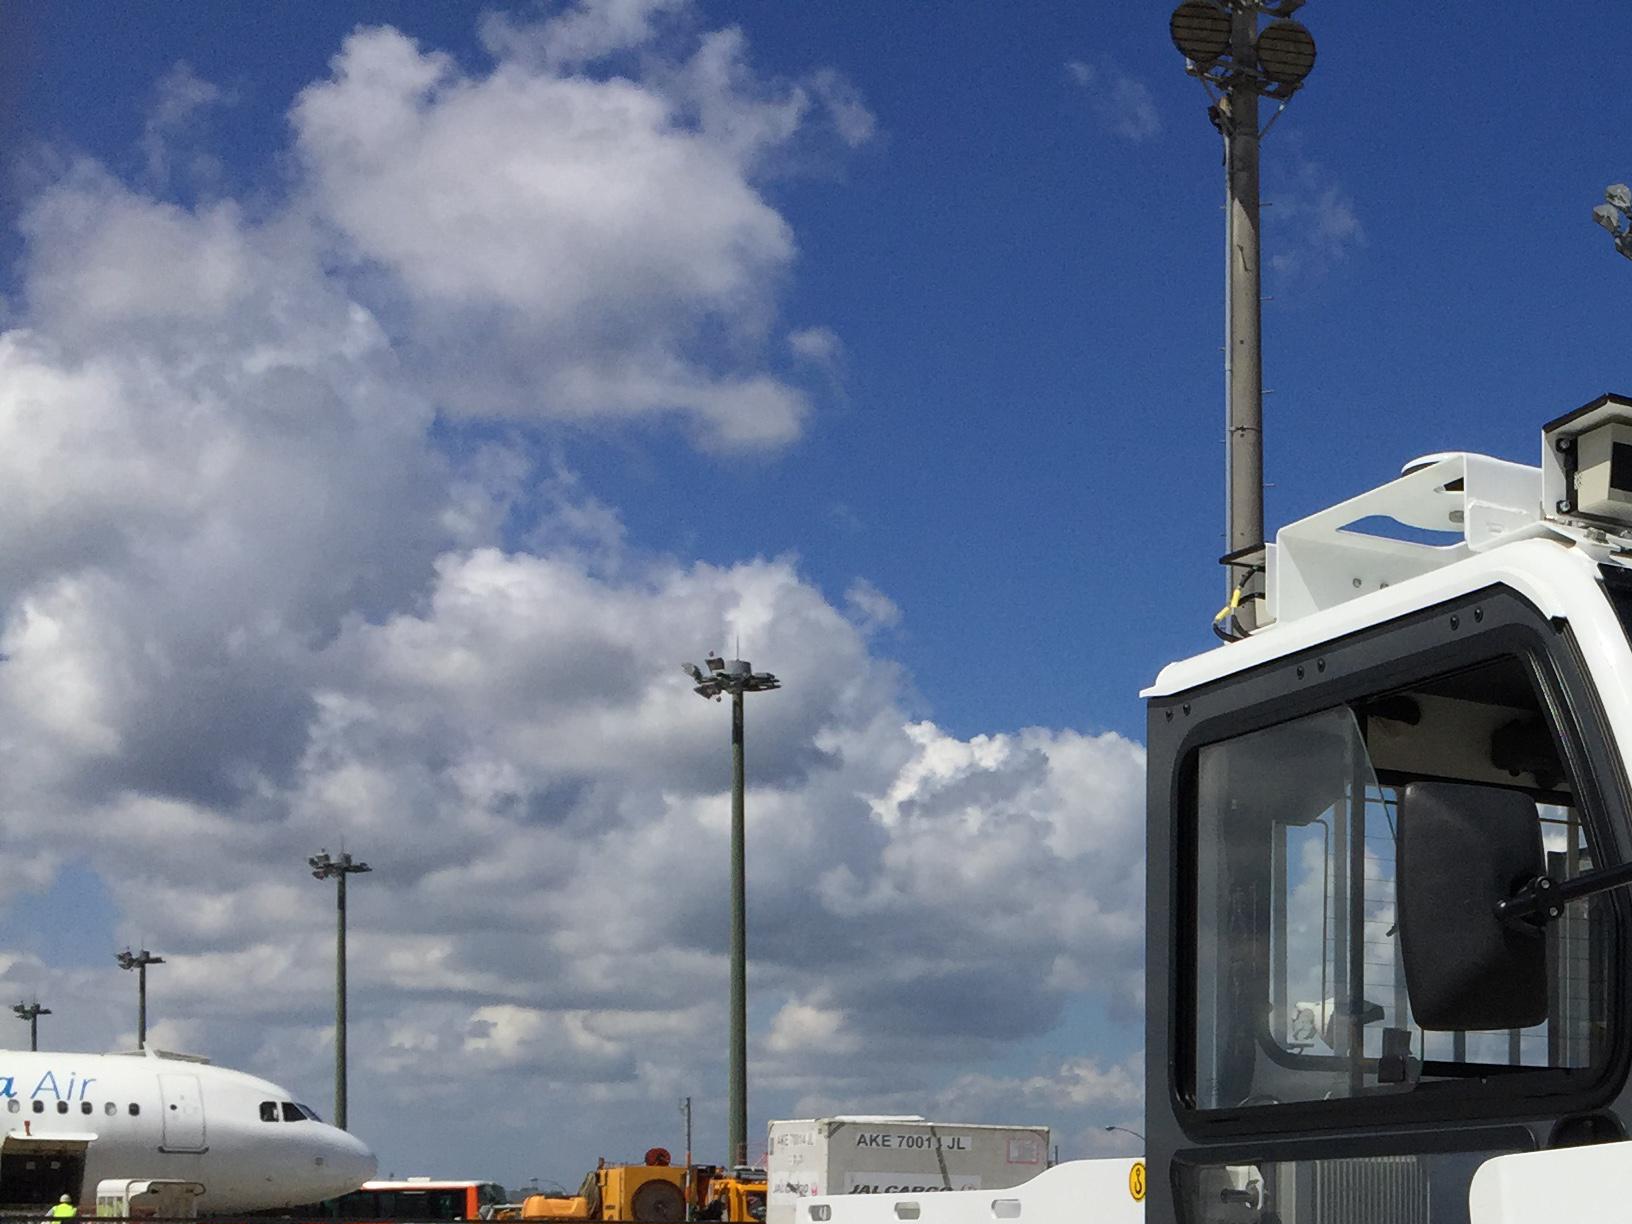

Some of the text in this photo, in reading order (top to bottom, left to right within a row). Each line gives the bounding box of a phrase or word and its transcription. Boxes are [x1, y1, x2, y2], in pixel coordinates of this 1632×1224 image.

[31, 1070, 96, 1101] Air
[856, 1133, 892, 1148] AKE
[946, 1136, 966, 1151] JL
